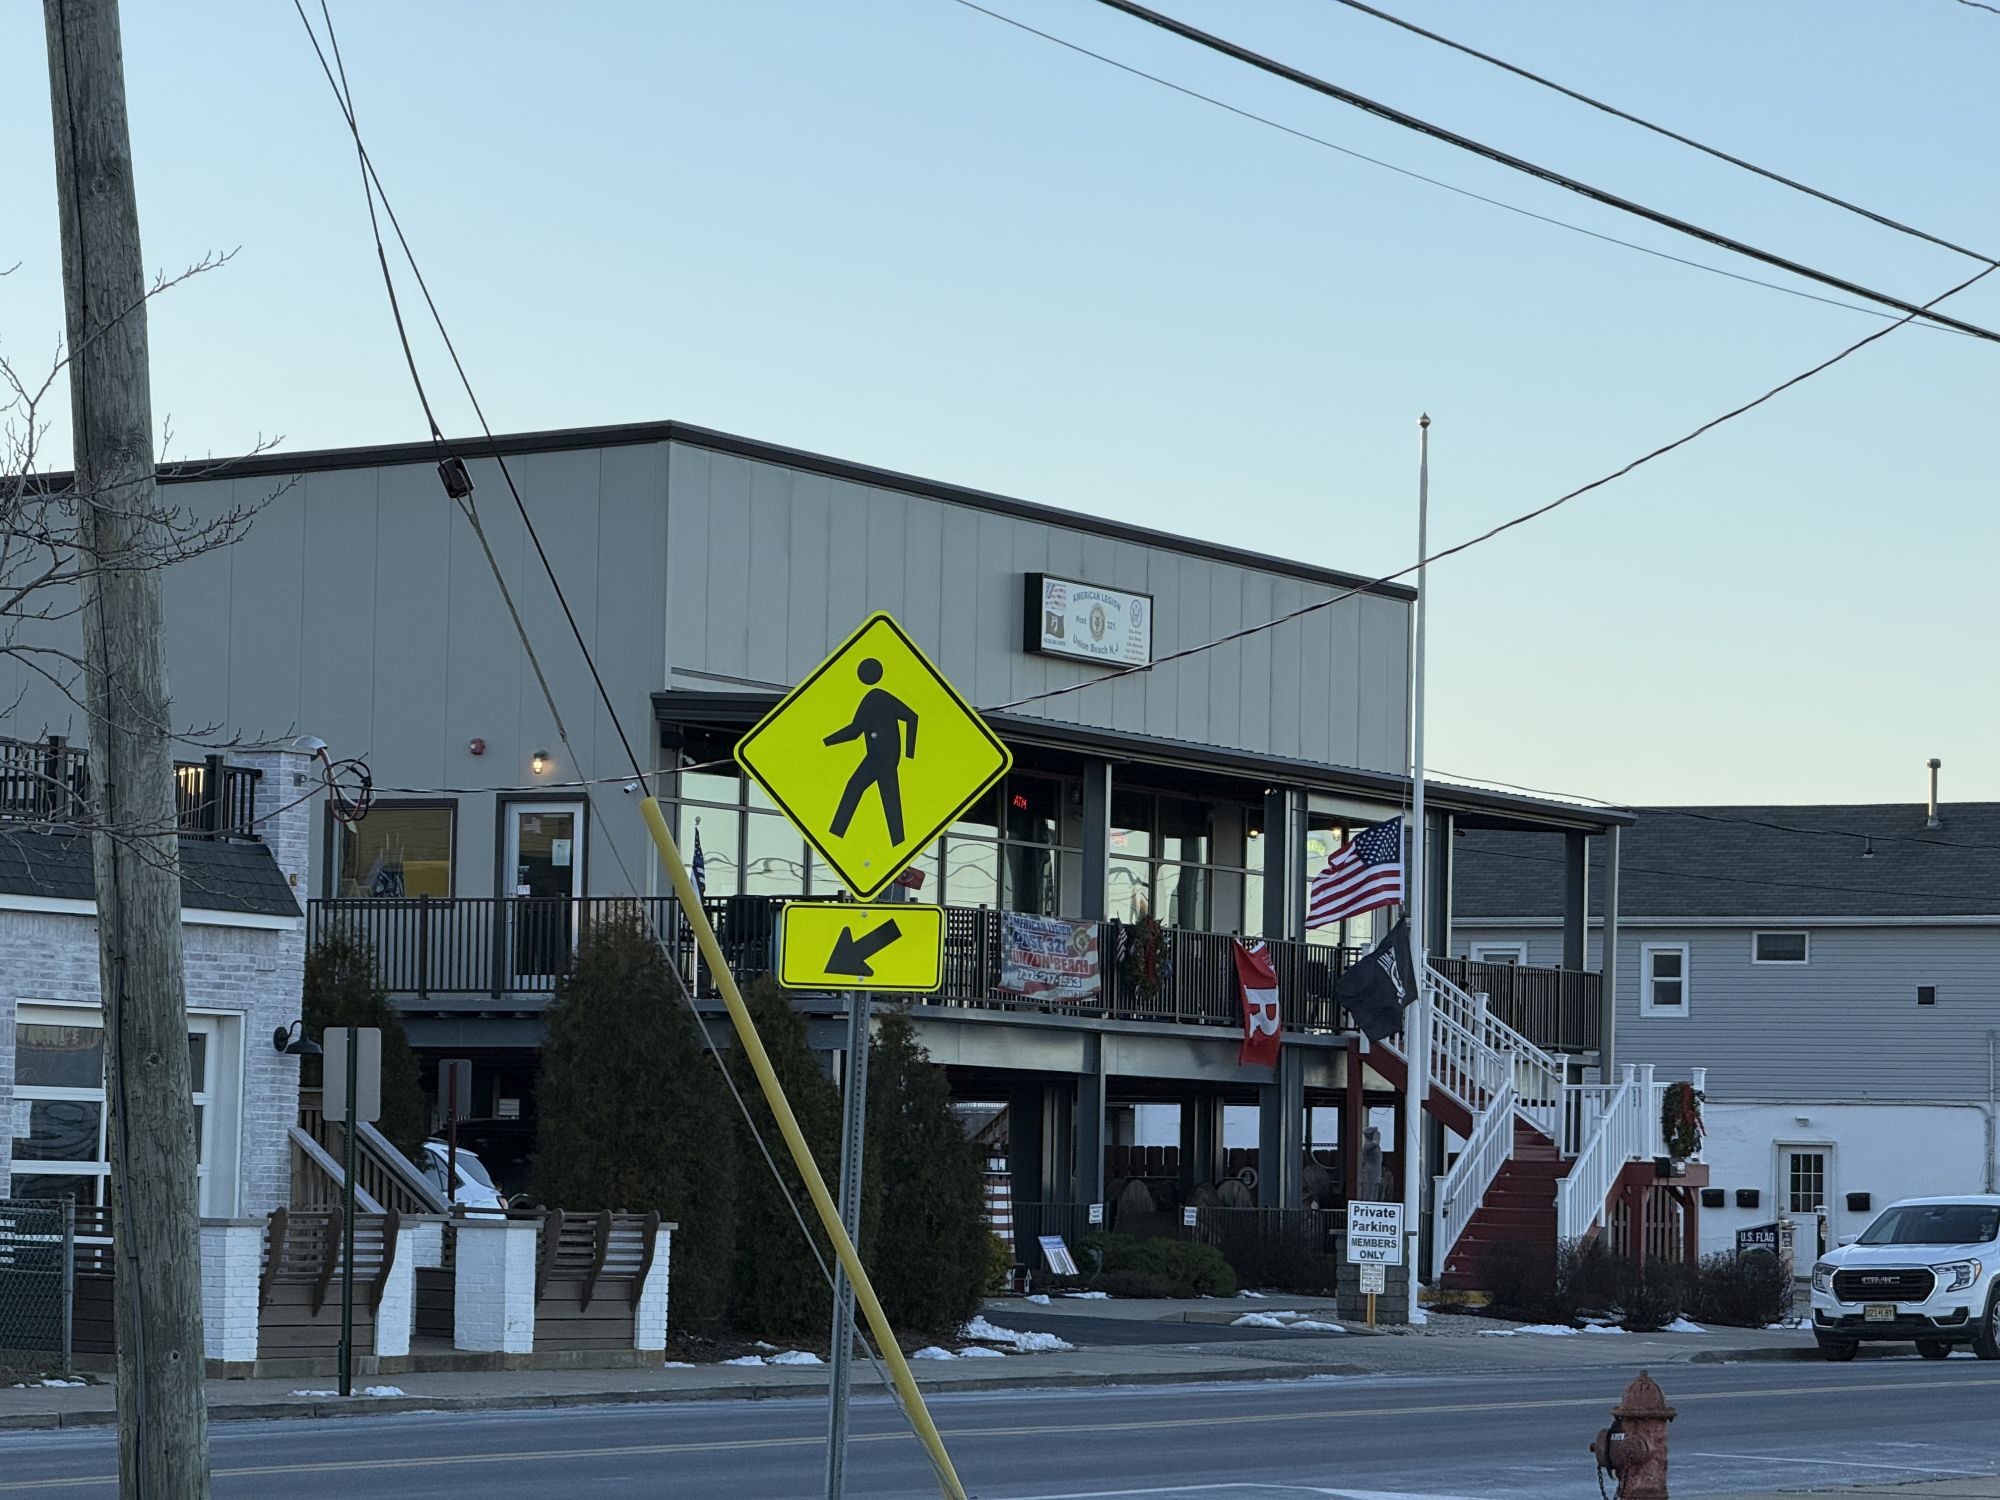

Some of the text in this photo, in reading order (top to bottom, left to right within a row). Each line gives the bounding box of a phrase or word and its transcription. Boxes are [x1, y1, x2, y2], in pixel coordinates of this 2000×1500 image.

[1073, 591, 1121, 612] AMERICAN LEGION
[1075, 615, 1116, 630] Post 321
[1073, 634, 1089, 651] Union
[1090, 643, 1108, 654] Beach
[1013, 795, 1027, 810] ATM
[1009, 915, 1046, 933] AMERICAN
[1012, 930, 1068, 954] POST 321
[1012, 948, 1090, 974] UNION BEACH
[1353, 1206, 1396, 1219] Private
[1352, 1220, 1397, 1235] Parking
[1351, 1238, 1397, 1248] MEMBERS
[1740, 1231, 1754, 1242] U.S.
[1756, 1232, 1775, 1243] FLAG
[1360, 1250, 1386, 1260] ONLY
[1861, 1276, 1900, 1285] GMC
